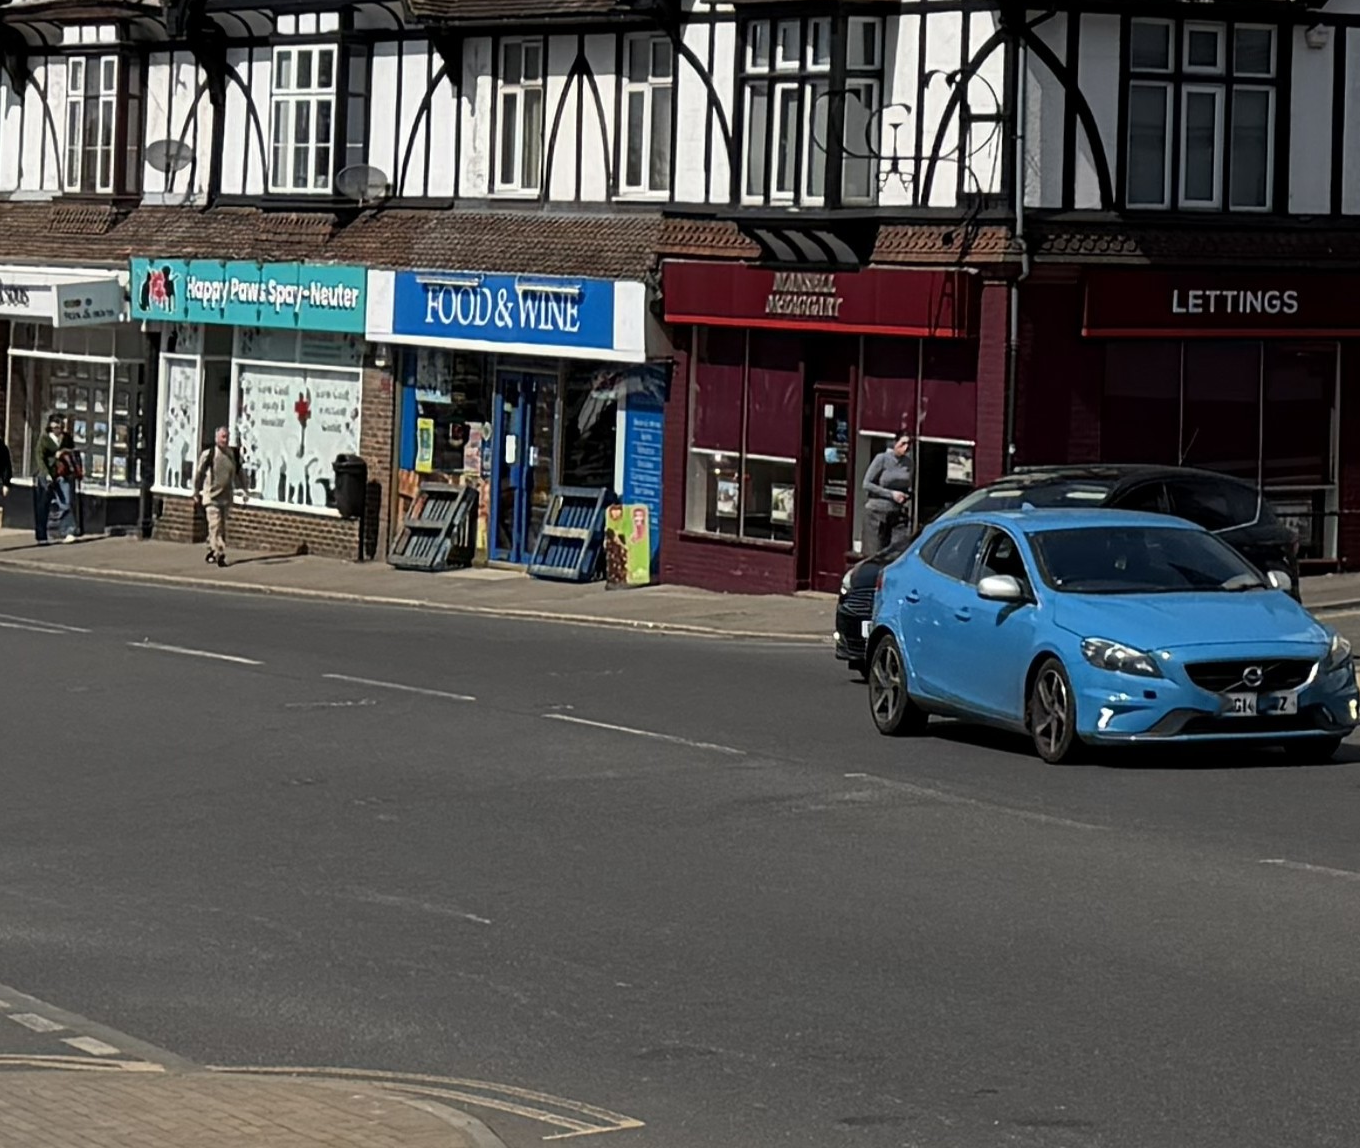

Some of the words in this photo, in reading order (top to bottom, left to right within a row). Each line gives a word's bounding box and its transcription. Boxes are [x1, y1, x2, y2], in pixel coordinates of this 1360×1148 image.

[187, 276, 230, 311] Happy
[231, 277, 266, 304] Paws
[424, 285, 493, 327] FOOD
[494, 288, 514, 330] &
[516, 289, 581, 333] WINE
[1172, 289, 1299, 314] LETTINGS
